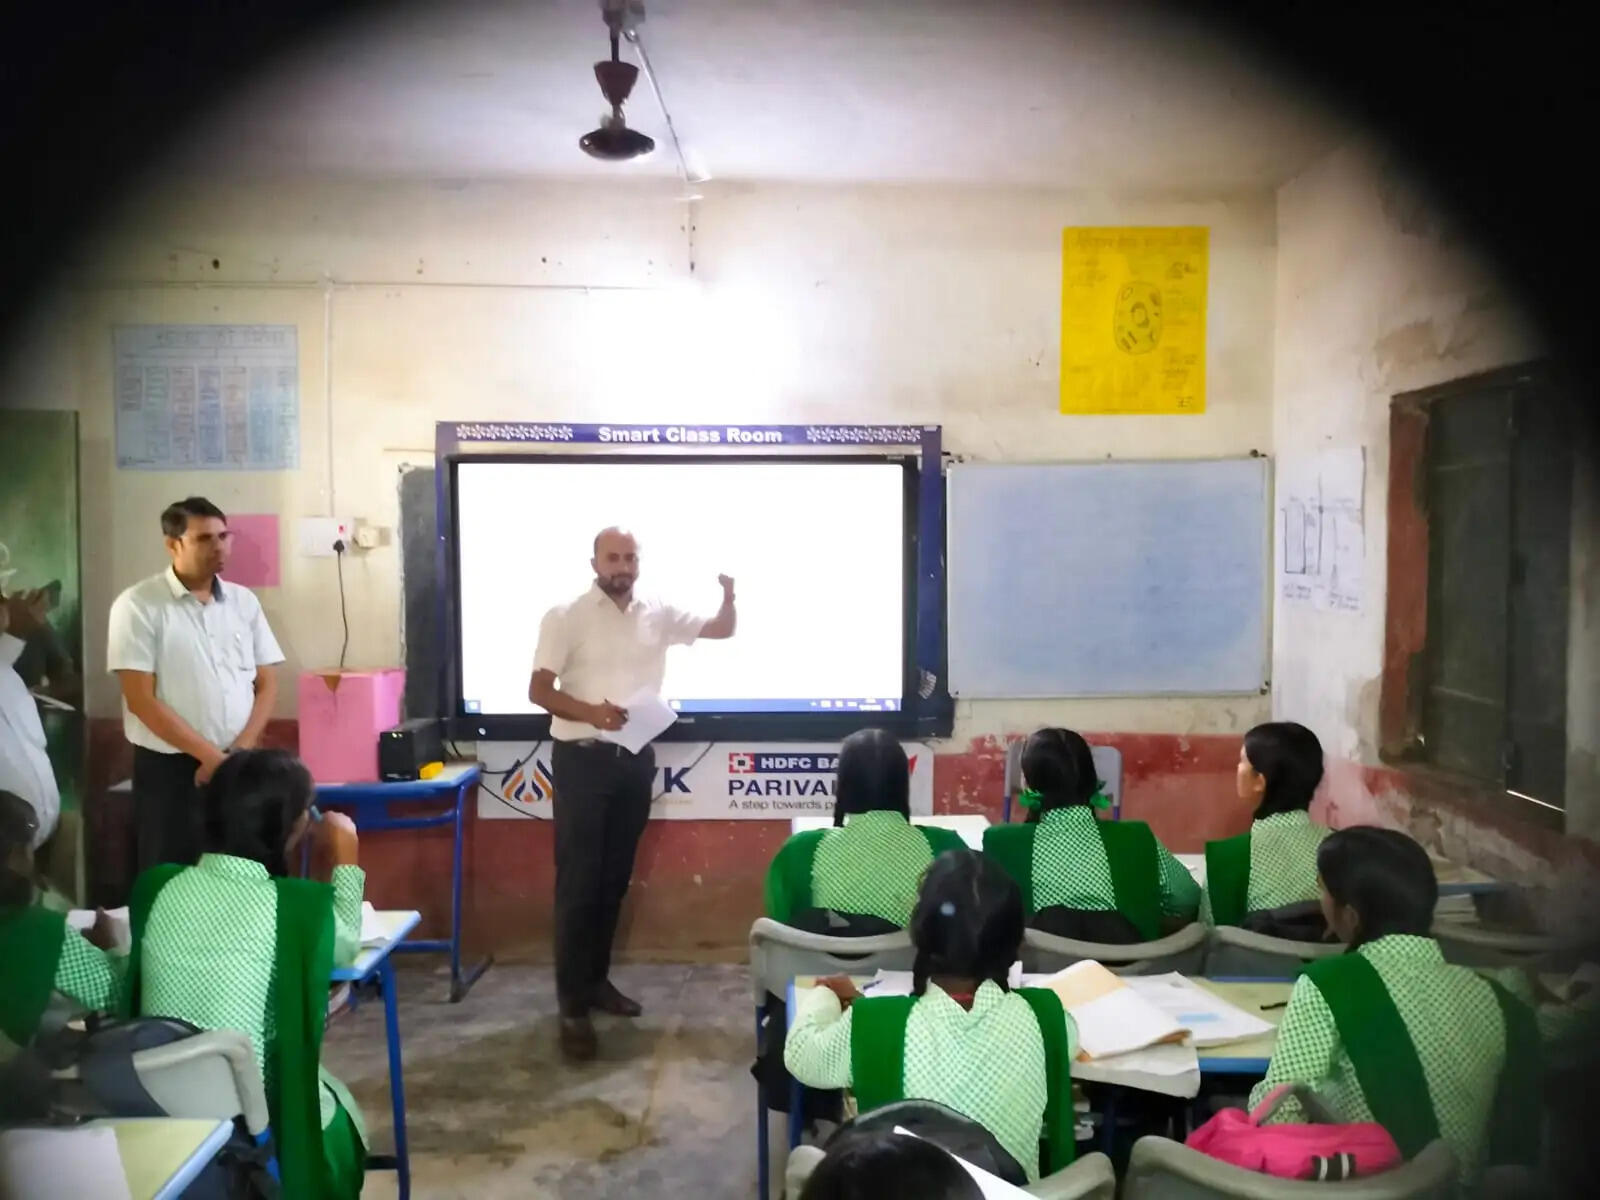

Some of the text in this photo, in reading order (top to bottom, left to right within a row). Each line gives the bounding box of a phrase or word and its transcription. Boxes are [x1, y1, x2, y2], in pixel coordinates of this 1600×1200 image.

[598, 426, 782, 444] Smart Class Room
[760, 757, 840, 769] HDFC BA
[728, 779, 838, 796] PARIVA
[728, 799, 738, 809] A
[741, 800, 768, 810] step
[772, 799, 822, 809] towards
